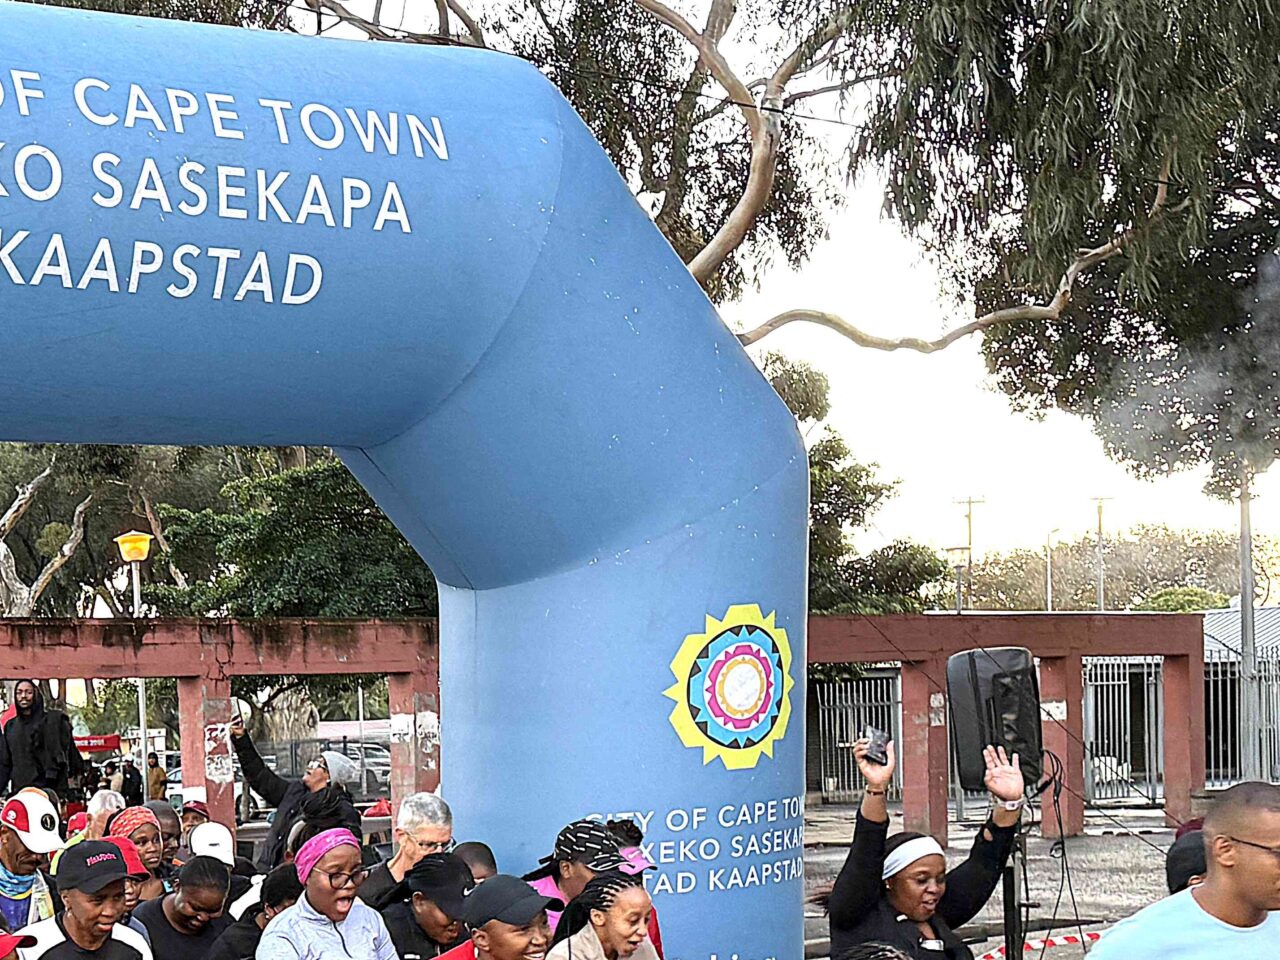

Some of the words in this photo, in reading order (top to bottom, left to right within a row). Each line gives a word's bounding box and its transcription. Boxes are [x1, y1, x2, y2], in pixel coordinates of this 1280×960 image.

[73, 77, 245, 141] CAPE
[258, 97, 449, 161] TOWN
[92, 151, 412, 234] SASEKAPA
[665, 808, 707, 832] OF
[718, 800, 778, 828] CAPE
[641, 837, 720, 864] XEKO
[642, 872, 697, 896] TAD
[708, 856, 803, 892] KAAPSTAD
